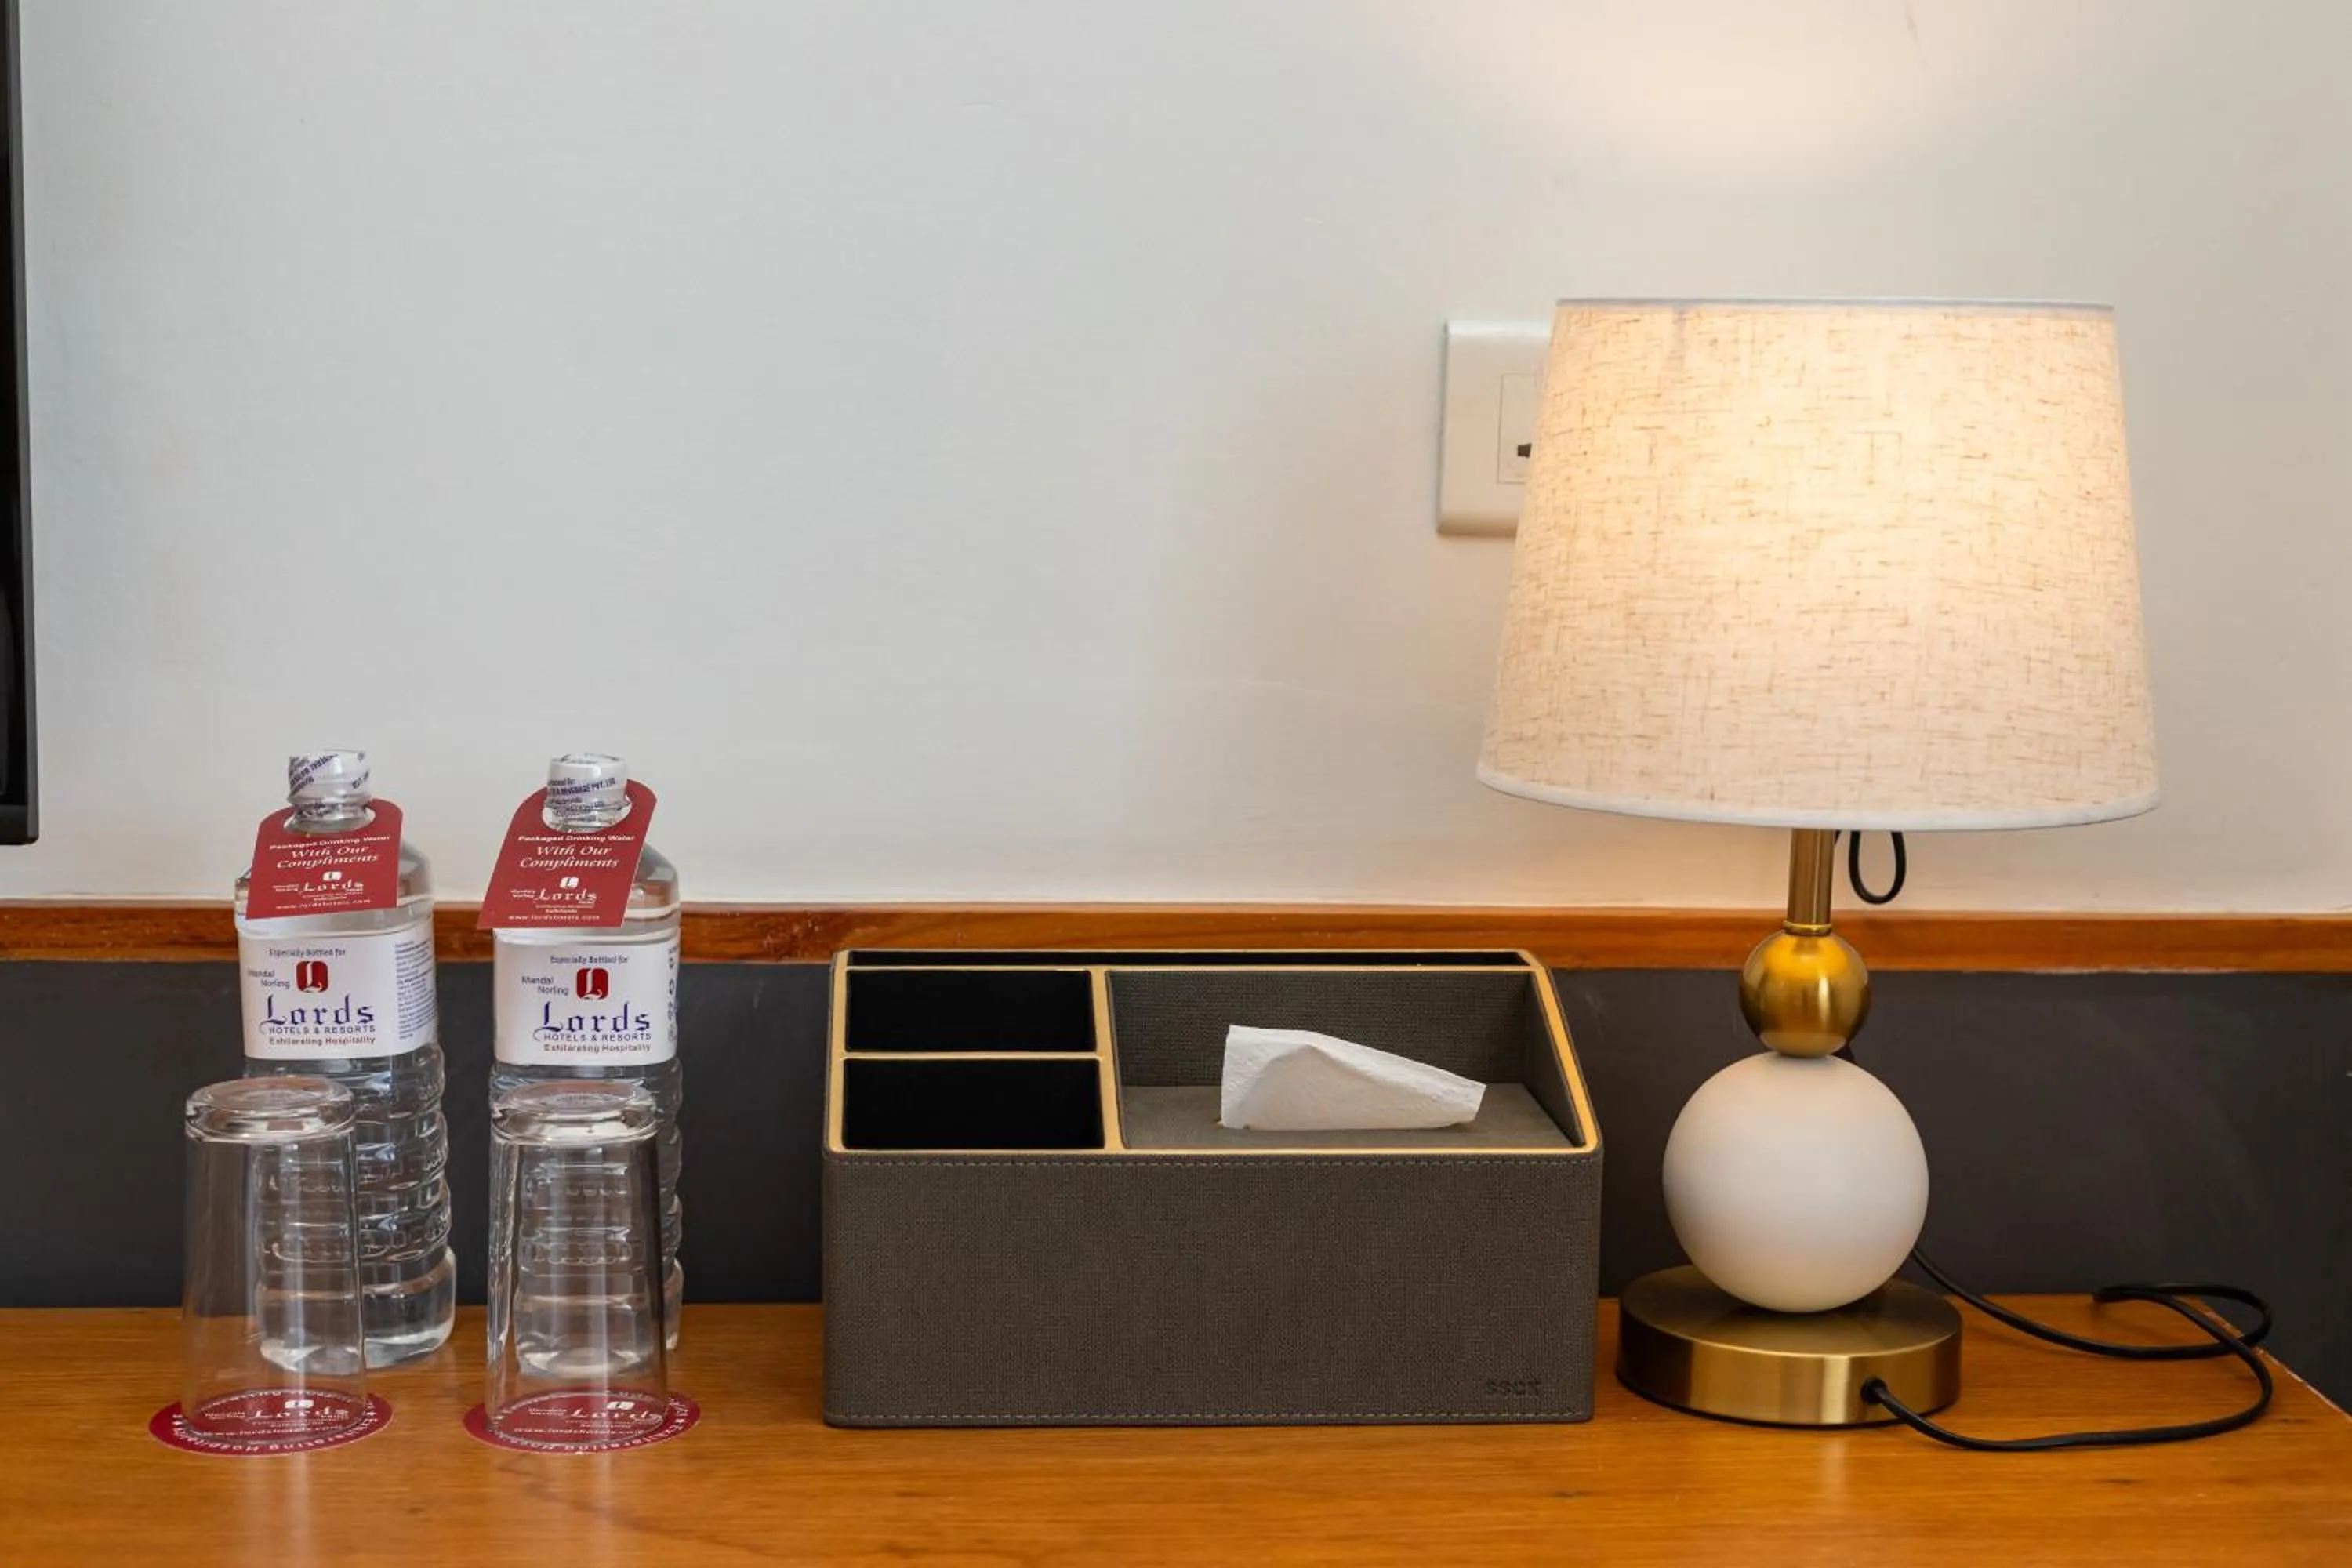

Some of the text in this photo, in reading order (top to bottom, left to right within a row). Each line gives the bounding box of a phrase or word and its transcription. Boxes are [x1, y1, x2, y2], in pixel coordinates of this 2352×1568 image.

[270, 839, 317, 850] Packaged
[319, 837, 360, 846] Drinking
[291, 846, 370, 858] With Our
[536, 844, 612, 856] With Our
[277, 854, 379, 869] Compliments
[520, 856, 620, 871] Compliments
[303, 879, 365, 891] Lords
[538, 888, 597, 901] Lords
[269, 948, 304, 958] Especially
[335, 949, 346, 958] for
[550, 956, 587, 965] Especially
[618, 956, 628, 964] for
[263, 993, 374, 1025] Lords
[538, 1001, 651, 1033] Lords
[269, 1025, 310, 1034] HOTELS
[325, 1025, 376, 1033] RESORTS
[269, 1036, 376, 1046] Exhilarating Hospitality
[601, 1033, 652, 1041] RESORTS
[544, 1044, 651, 1054] Exhilarating Hospitality
[254, 1406, 349, 1418] Lords
